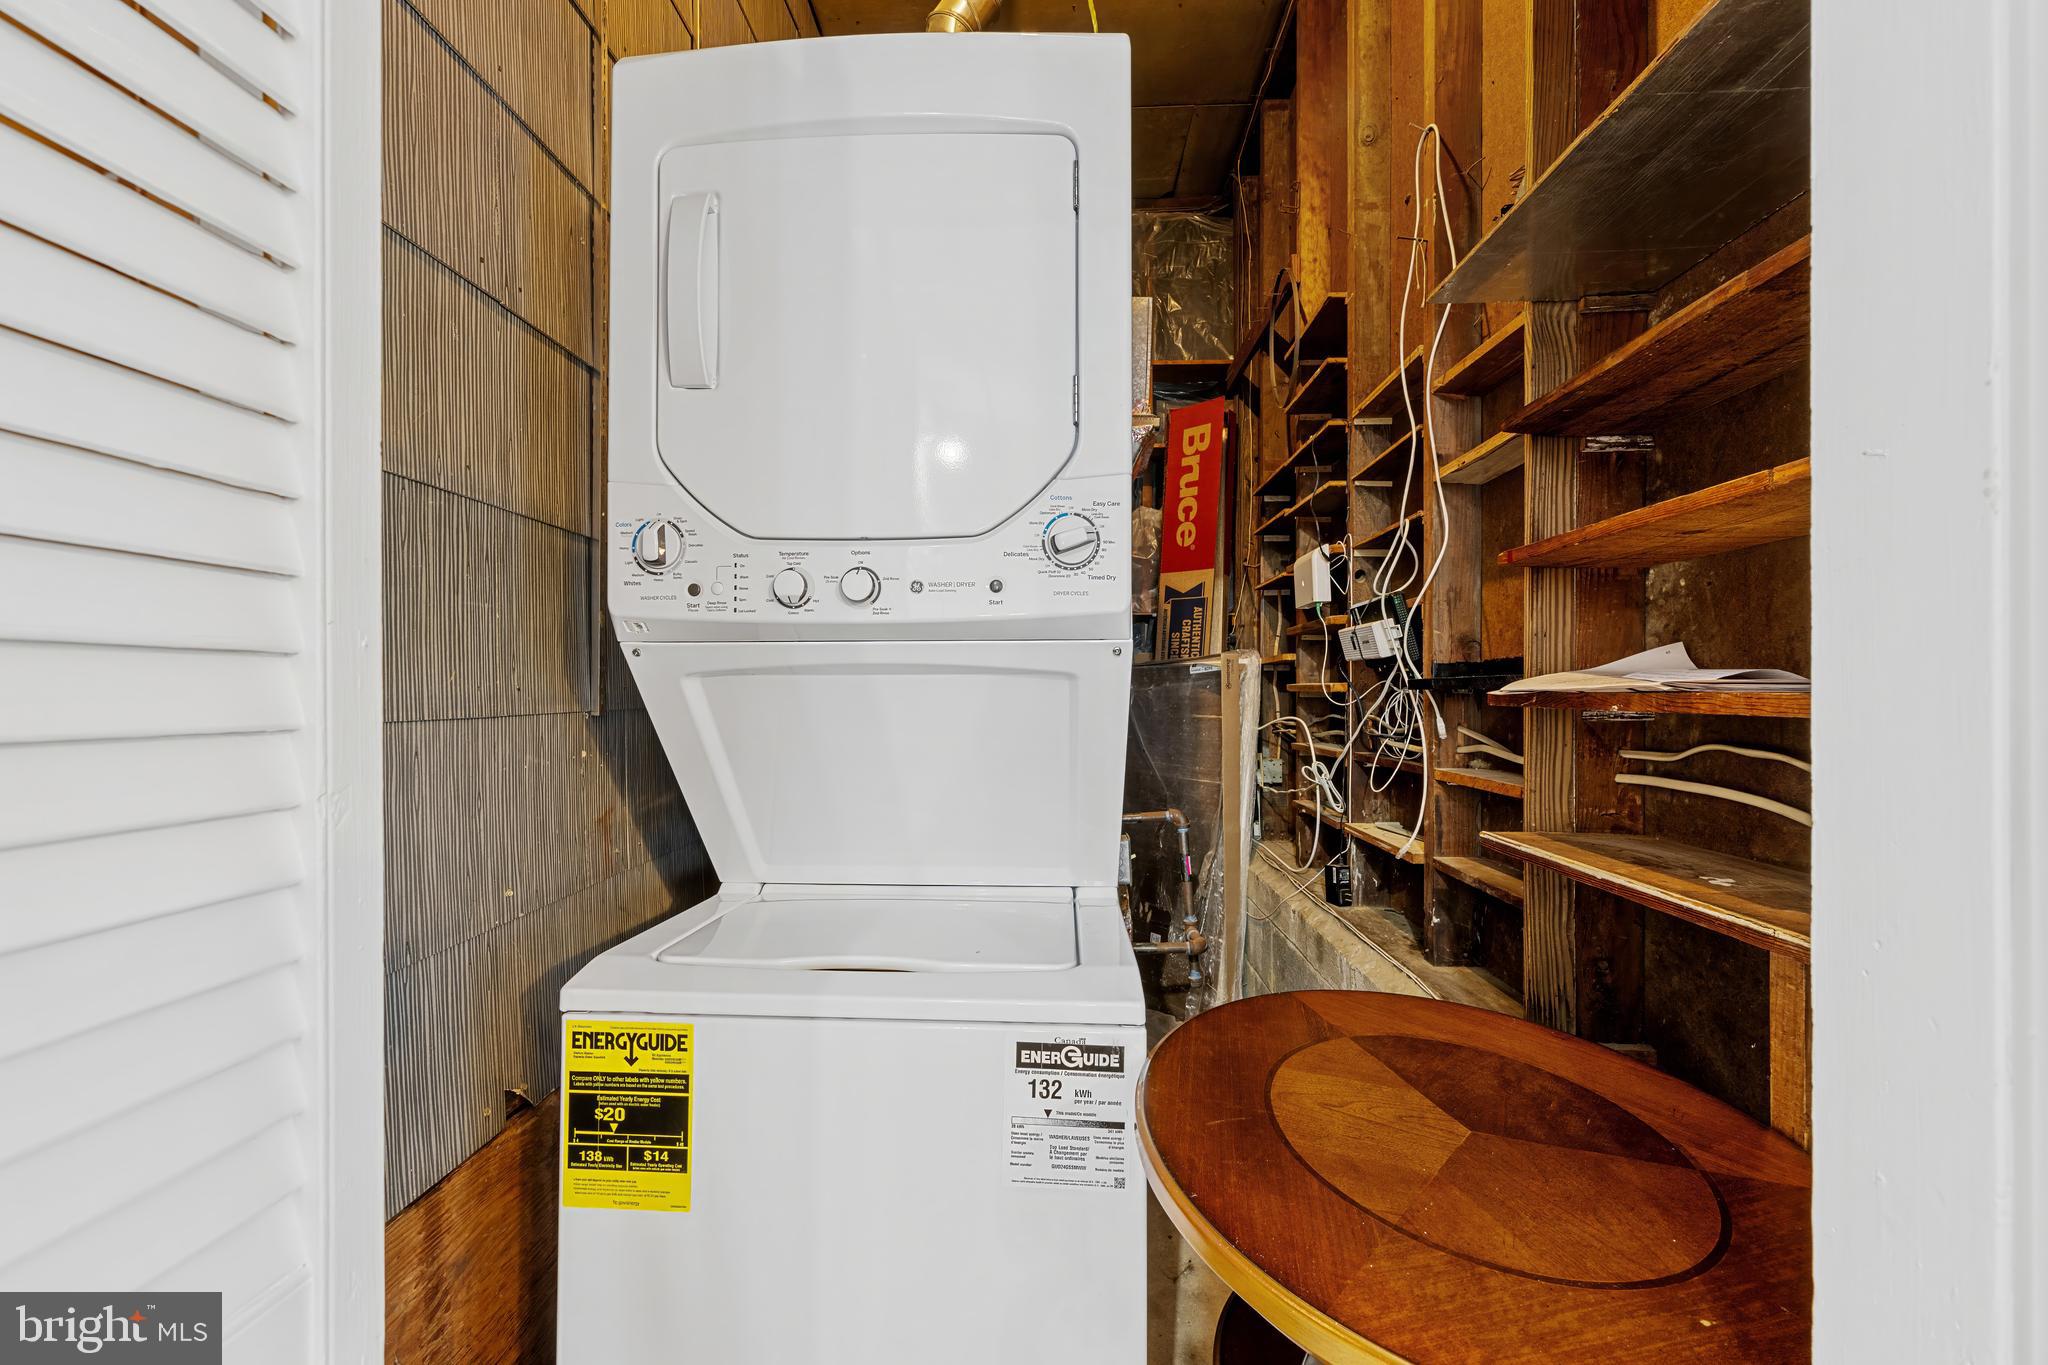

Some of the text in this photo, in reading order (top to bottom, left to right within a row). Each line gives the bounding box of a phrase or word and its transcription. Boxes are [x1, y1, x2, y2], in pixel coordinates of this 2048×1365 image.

[1176, 423, 1212, 548] Bruce
[1181, 619, 1191, 658] CRAFTS
[1191, 606, 1202, 658] AUTHENTIC
[1170, 632, 1180, 659] SINC
[1028, 1079, 1062, 1100] 132
[1074, 1089, 1092, 1098] kWh
[594, 1107, 626, 1121] $20
[579, 1150, 603, 1162] 138
[644, 1150, 669, 1162] $14
